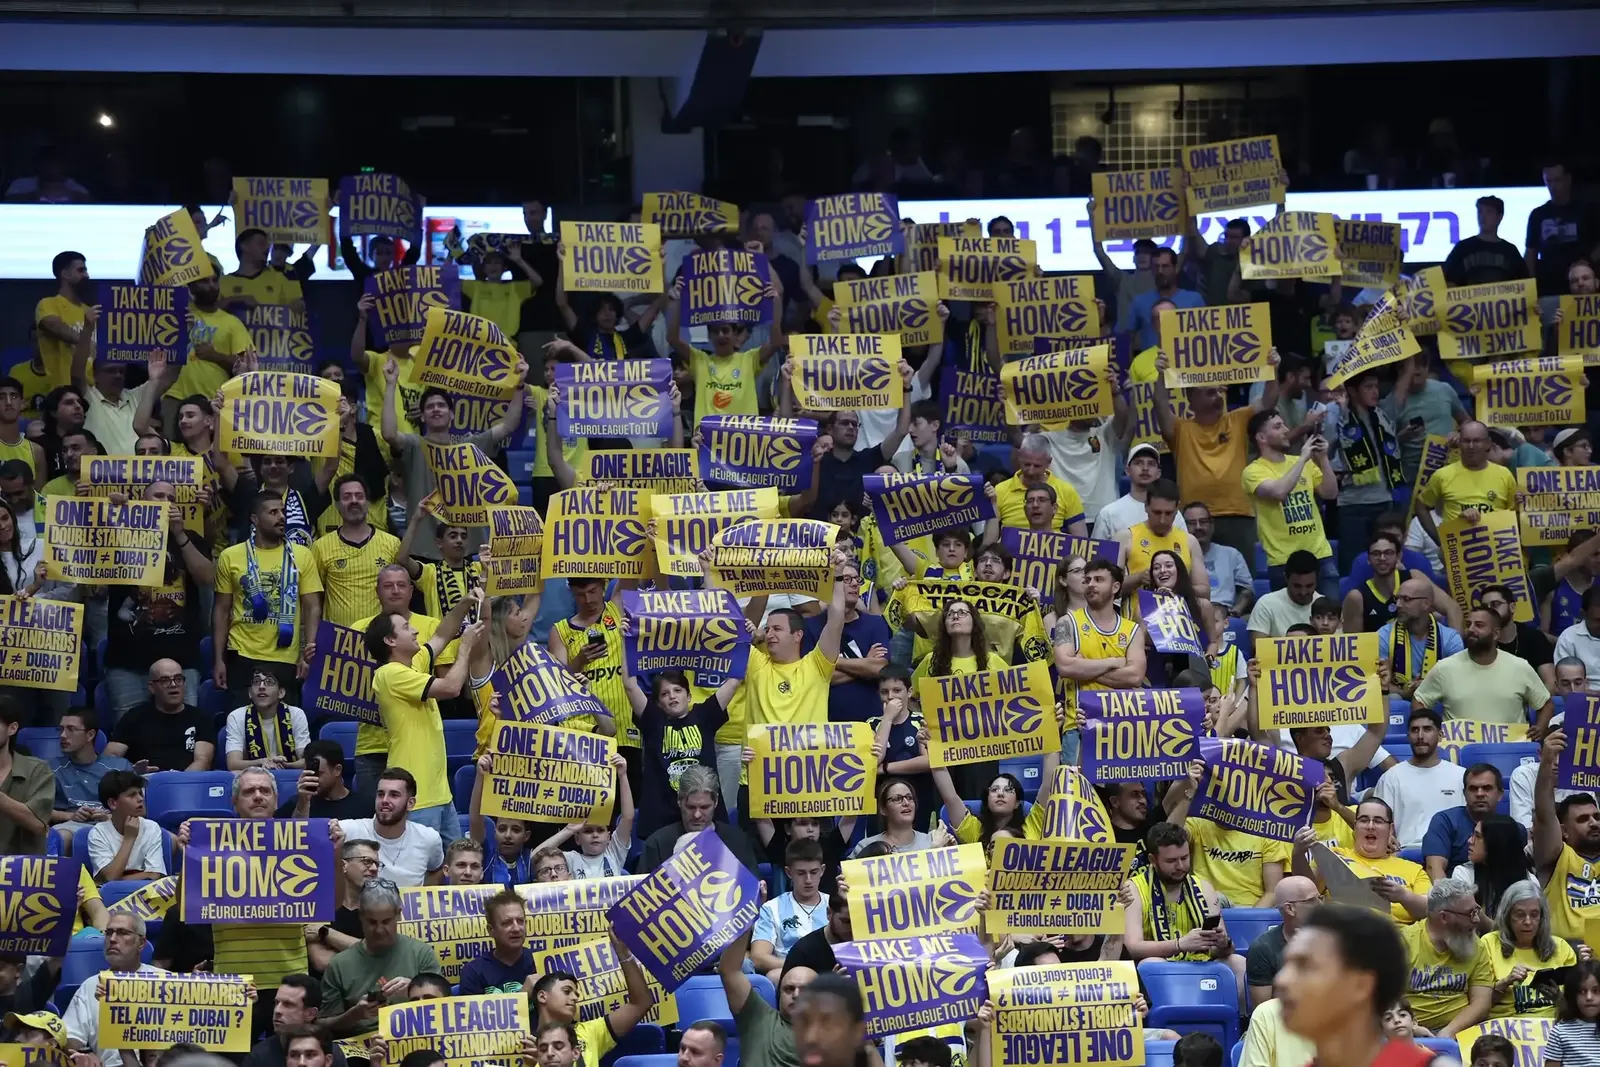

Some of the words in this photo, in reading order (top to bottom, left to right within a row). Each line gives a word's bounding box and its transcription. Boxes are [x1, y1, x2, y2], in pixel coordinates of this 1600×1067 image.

[1189, 143, 1220, 170] ONE
[1224, 138, 1274, 165] LEAGUE
[246, 178, 286, 197] TAKE
[289, 178, 312, 198] ME
[1106, 170, 1146, 194] TAKE
[1150, 168, 1173, 188] ME
[656, 194, 695, 211] TAKE
[814, 195, 857, 216] TAKE
[860, 193, 884, 214] ME
[576, 224, 616, 242] TAKE
[620, 224, 644, 244] ME
[954, 238, 992, 254] TAKE
[996, 238, 1020, 254] ME
[691, 250, 730, 274] TAKE
[733, 250, 756, 274] ME
[416, 266, 442, 288] ME
[848, 279, 892, 303] TAKE
[894, 274, 920, 297] ME
[1007, 279, 1051, 302] TAKE
[1054, 277, 1079, 300] ME
[111, 286, 149, 310] TAKE
[153, 286, 174, 310] ME
[442, 310, 482, 342] TAKE
[1176, 310, 1222, 333] TAKE
[1226, 306, 1252, 328] ME
[804, 336, 851, 356] TAKE
[856, 336, 883, 354] ME
[1483, 330, 1526, 352] TAKE
[571, 362, 619, 383] TAKE
[624, 360, 652, 382] ME
[1018, 352, 1059, 372] TAKE
[1064, 348, 1090, 367] ME
[1491, 356, 1534, 374] TAKE
[1538, 356, 1564, 372] ME
[240, 373, 288, 398] TAKE
[291, 374, 322, 399] ME
[769, 416, 800, 434] ME
[90, 459, 128, 484] ONE
[132, 460, 195, 484] LEAGUE
[592, 454, 630, 478] ONE
[634, 452, 693, 478] LEAGUE
[1526, 470, 1562, 494] ONE
[55, 500, 94, 526] ONE
[98, 502, 162, 530] LEAGUE
[560, 491, 604, 516] TAKE
[610, 490, 638, 516] ME
[669, 493, 721, 516] TAKE
[728, 490, 758, 512] ME
[492, 510, 512, 536] ONE
[514, 510, 544, 534] LEAGUE
[1528, 514, 1544, 528] TEL
[1548, 513, 1570, 528] AVIV
[50, 526, 95, 546] DOUBLE
[95, 529, 162, 548] STANDARDS
[722, 522, 763, 548] ONE
[764, 522, 830, 548] LEAGUE
[1018, 532, 1063, 560] TAKE
[52, 546, 68, 562] TEL
[72, 548, 97, 564] AVIV
[113, 551, 148, 566] DUBAI
[716, 548, 760, 566] DOUBLE
[761, 548, 830, 568] STANDARDS
[740, 570, 764, 582] AVIV
[784, 569, 820, 582] DUBAI
[638, 591, 695, 614] TAKE
[700, 590, 730, 614] ME
[8, 604, 76, 632] LEAGUE
[26, 652, 62, 670] DUBAI
[1274, 639, 1325, 665] TAKE
[1329, 636, 1358, 662] ME
[938, 671, 994, 703] TAKE
[997, 666, 1030, 693] ME
[1096, 691, 1151, 718] TAKE
[1154, 690, 1185, 714] ME
[498, 725, 536, 756] ONE
[543, 729, 609, 766] LEAGUE
[766, 724, 820, 752] TAKE
[824, 724, 856, 750] ME
[492, 754, 538, 778] DOUBLE
[538, 760, 611, 787] STANDARDS
[1219, 740, 1269, 770] TAKE
[1274, 750, 1304, 780] ME
[492, 778, 510, 796] TEL
[512, 780, 538, 800] AVIV
[558, 786, 595, 804] DUBAI
[206, 822, 266, 852] TAKE
[274, 821, 309, 851] ME
[862, 852, 923, 888] TAKE
[927, 847, 964, 878] ME
[1002, 844, 1050, 871] ONE
[1052, 844, 1126, 872] LEAGUE
[1208, 848, 1254, 864] MACCABI
[20, 858, 57, 889] ME
[618, 865, 681, 924] TAKE
[673, 842, 712, 882] ME
[996, 872, 1045, 890] DOUBLE
[1046, 872, 1121, 891] STANDARDS
[1582, 864, 1590, 879] 8
[526, 886, 571, 913] ONE
[994, 894, 1018, 911] TEL
[1018, 894, 1045, 911] AVIV
[1066, 894, 1102, 911] DUBAI
[852, 938, 920, 964] TAKE
[108, 979, 162, 1004] DOUBLE
[164, 980, 246, 1006] STANDARDS
[1012, 986, 1052, 1006] DUBAI
[1074, 984, 1104, 1002] AVIV
[1108, 982, 1130, 1000] TEL
[1208, 982, 1216, 990] 16
[46, 1014, 62, 1033] 23
[109, 1006, 132, 1024] TEL
[135, 1007, 164, 1025] AVIV
[188, 1008, 230, 1028] DUBAI
[390, 1008, 438, 1038] ONE
[442, 998, 518, 1034] LEAGUE
[1000, 1006, 1078, 1032] STANDARDS
[1004, 1031, 1084, 1066] LEAGUE
[1087, 1030, 1132, 1064] ONE
